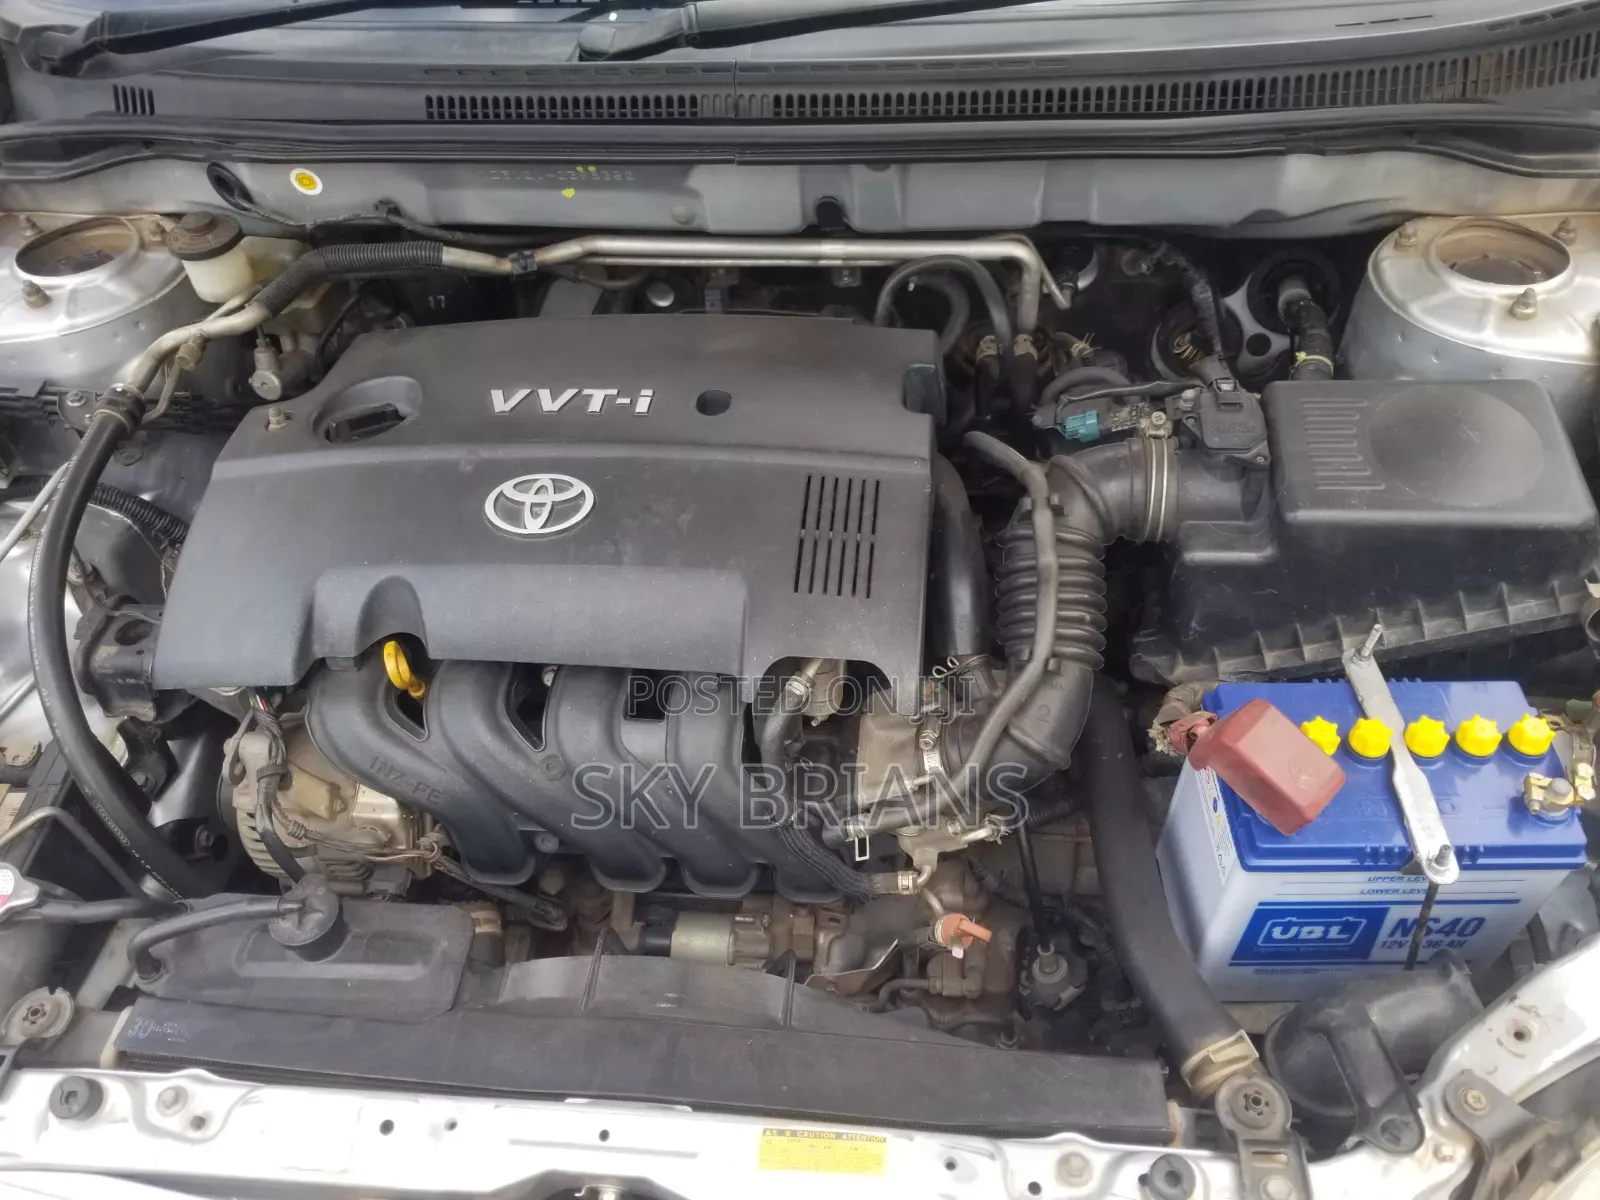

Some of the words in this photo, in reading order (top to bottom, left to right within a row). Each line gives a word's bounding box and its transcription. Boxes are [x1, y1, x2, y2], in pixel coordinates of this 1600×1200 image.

[490, 388, 654, 415] VVT-i
[1270, 925, 1350, 940] UBL
[1387, 917, 1486, 938] NS40
[1381, 940, 1409, 949] 12V
[797, 1131, 836, 1140] CAUTION
[841, 1133, 885, 1142] ATTENTION
